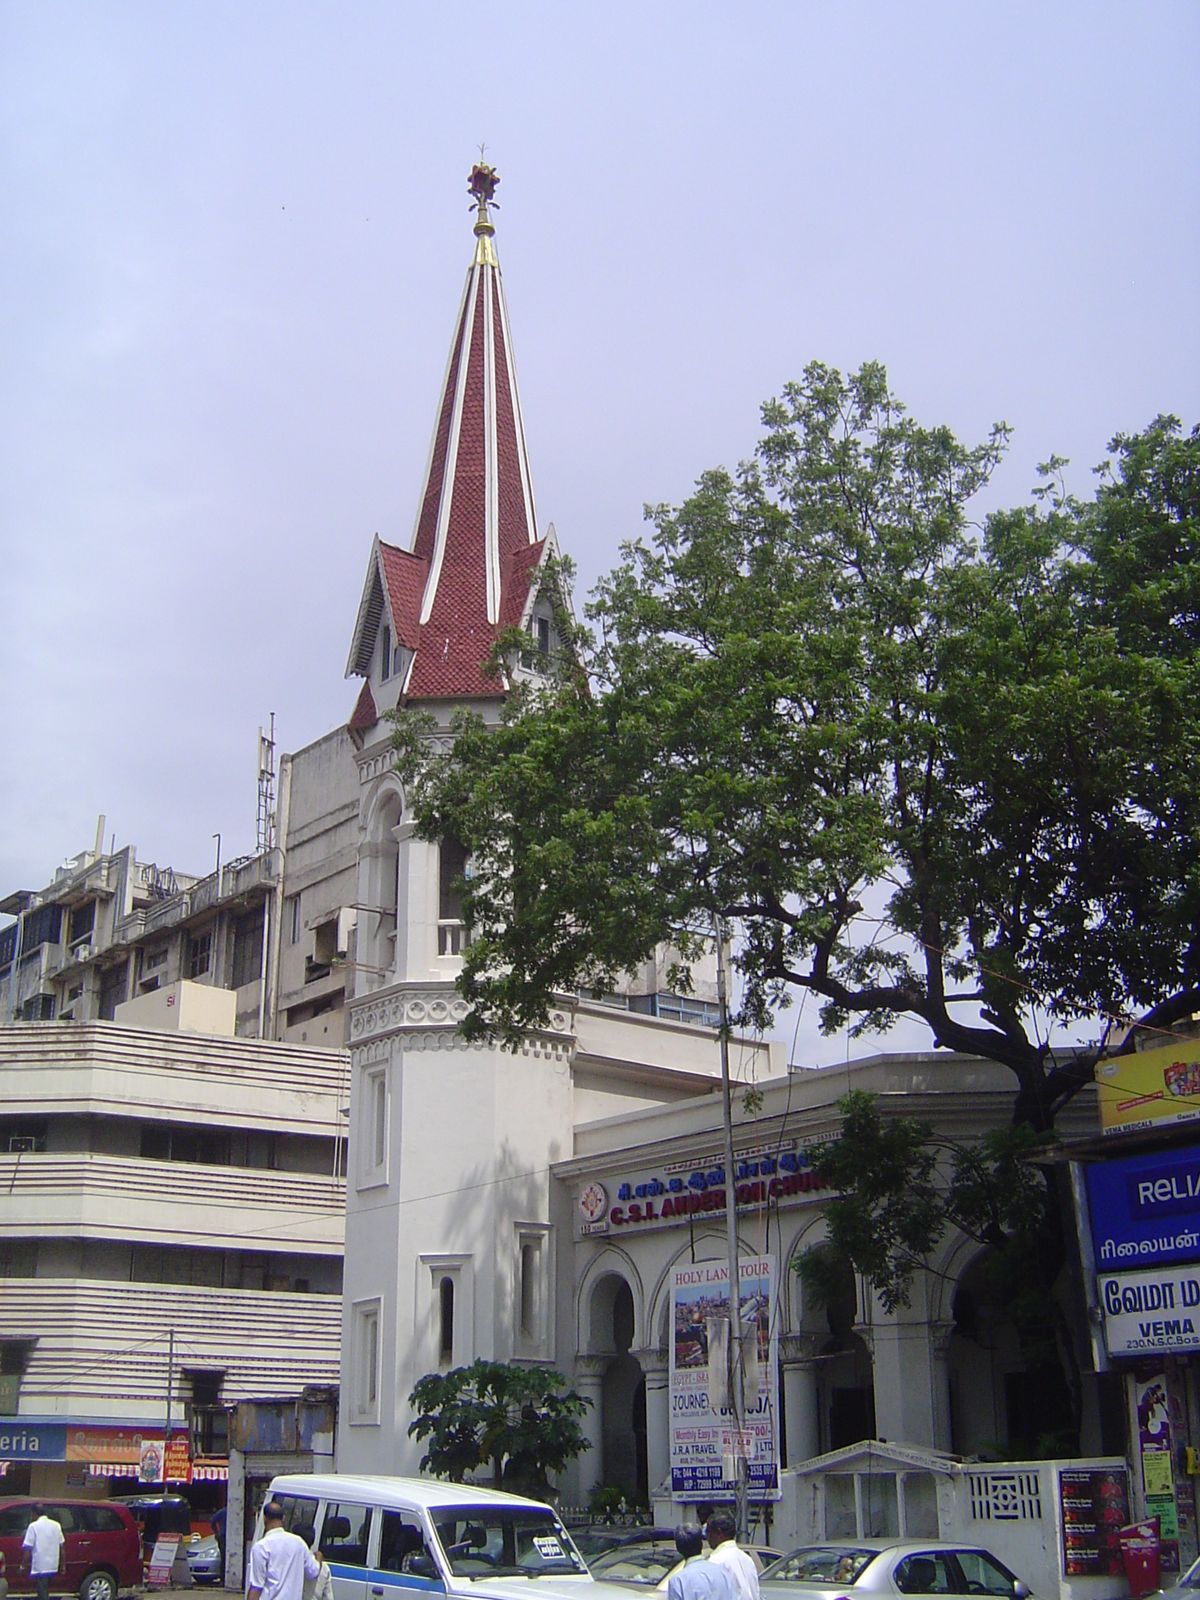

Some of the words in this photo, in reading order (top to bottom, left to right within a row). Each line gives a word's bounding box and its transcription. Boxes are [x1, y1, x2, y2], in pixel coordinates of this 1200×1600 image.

[660, 1181, 766, 1218] ANDERON
[675, 1270, 703, 1286] HOLY
[706, 1268, 728, 1281] LAN
[740, 1262, 769, 1277] TOUR
[1139, 1318, 1195, 1338] VEMA
